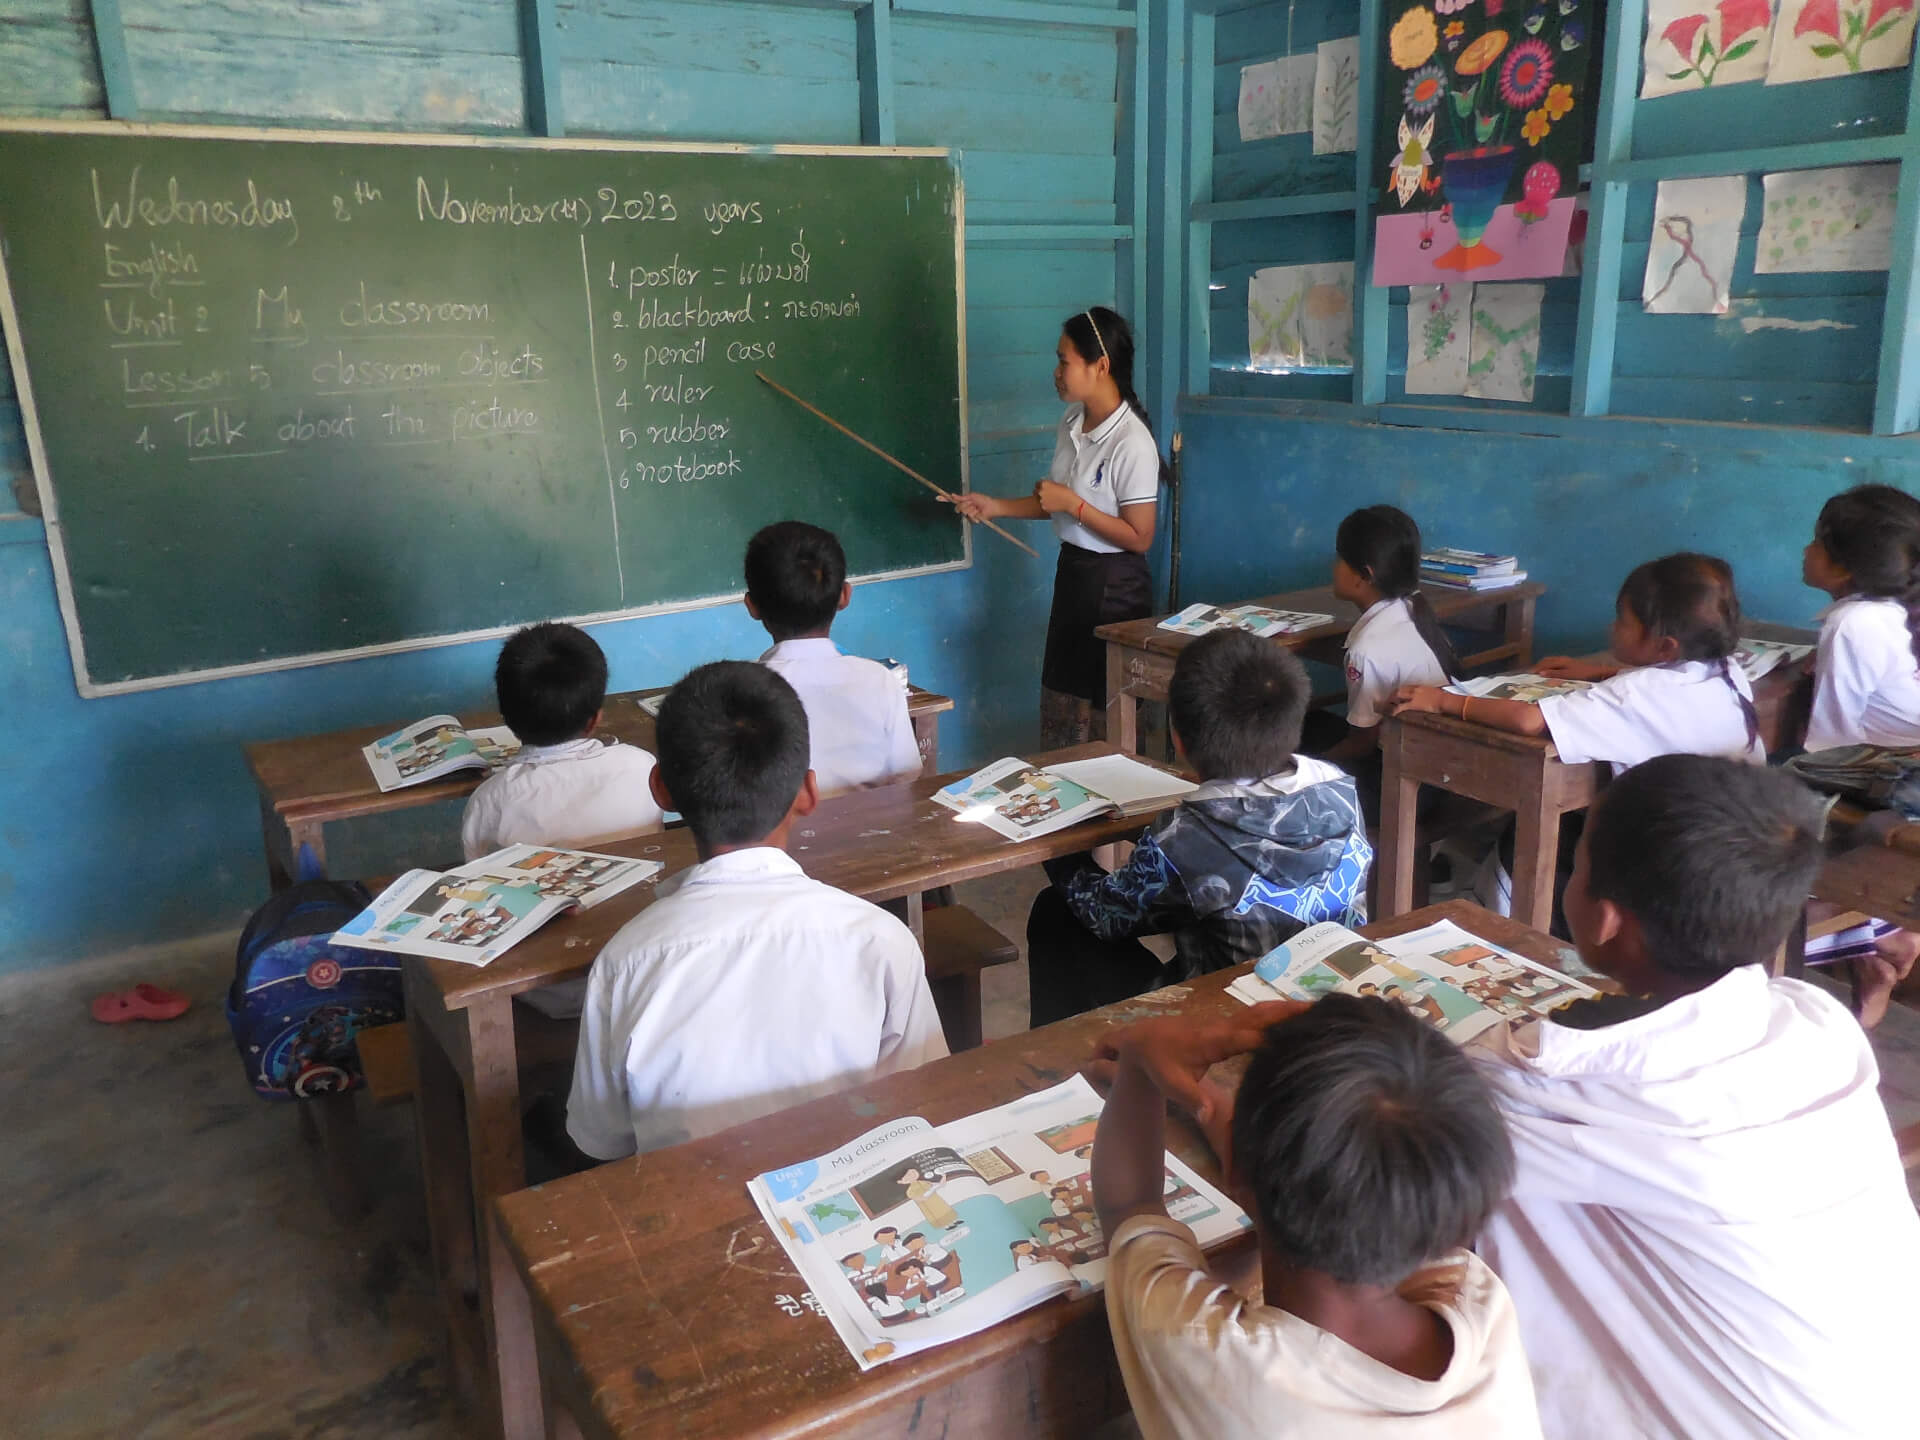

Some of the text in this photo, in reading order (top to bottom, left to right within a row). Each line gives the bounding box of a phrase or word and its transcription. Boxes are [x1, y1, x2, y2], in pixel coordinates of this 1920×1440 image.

[91, 164, 298, 247] Wednesday
[598, 187, 678, 223] 2023
[703, 200, 764, 235] years
[104, 240, 199, 298] English
[628, 252, 700, 300] poster
[104, 297, 177, 337] Unit
[256, 285, 308, 346] My
[638, 292, 755, 330] blackboard
[122, 358, 232, 393] Lesson
[643, 337, 706, 380] pencil
[615, 374, 715, 413] 4 ruler
[174, 407, 246, 448] Talk
[278, 404, 355, 441] about
[453, 396, 538, 441] picture
[618, 414, 730, 450] 5 rubber
[636, 450, 742, 485] notebook
[831, 1122, 920, 1169] My classroom
[775, 1167, 804, 1183] Unit
